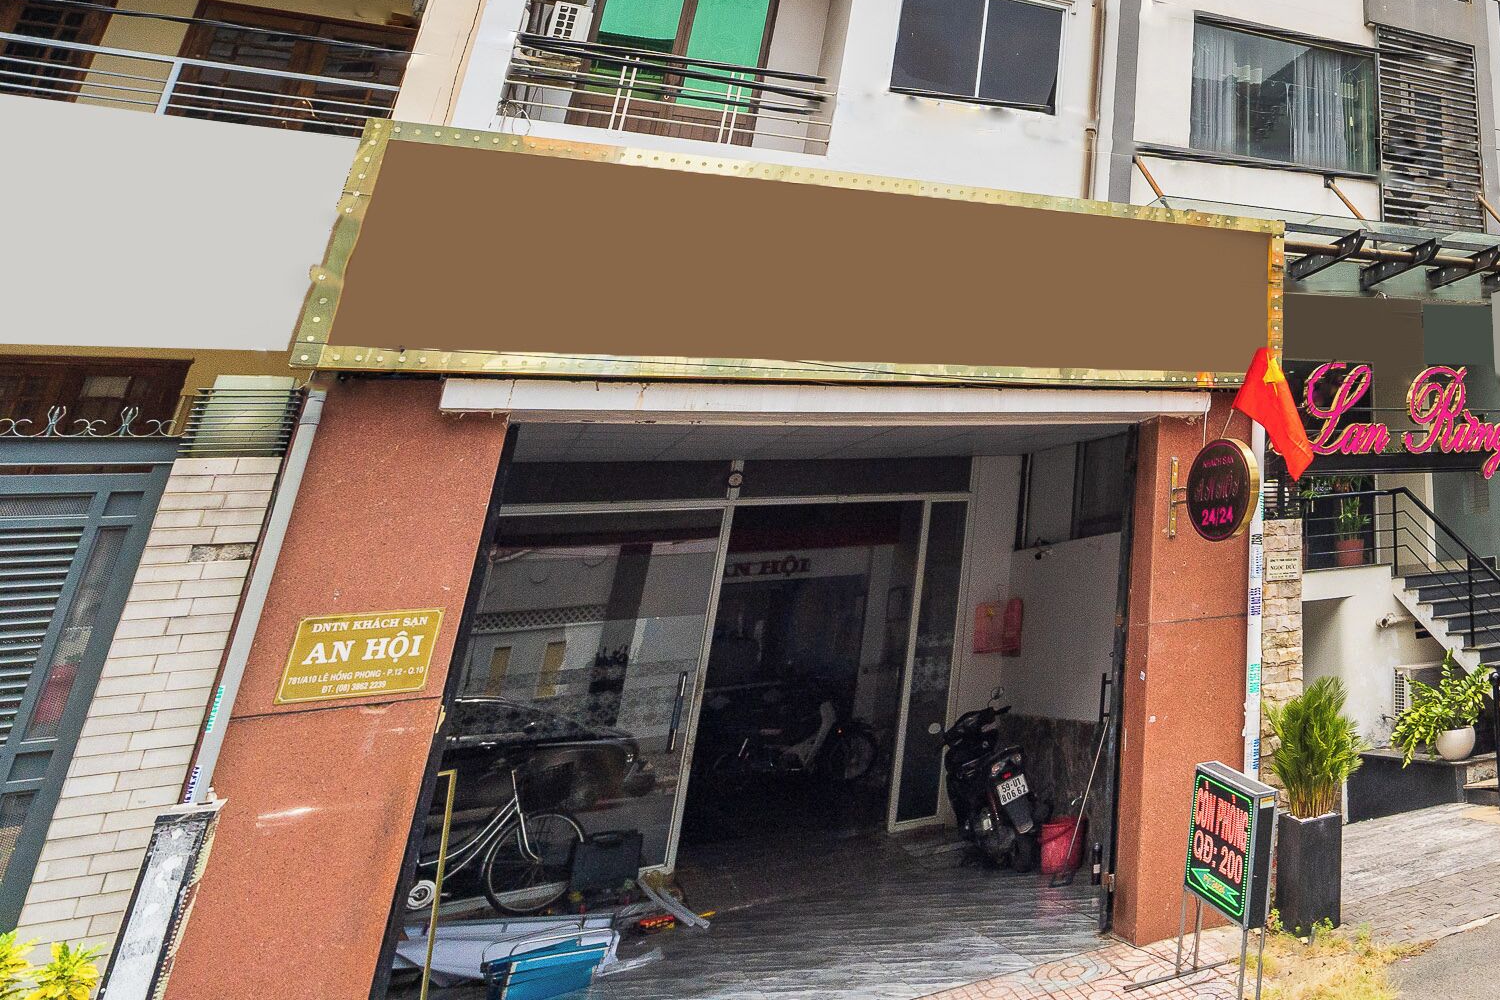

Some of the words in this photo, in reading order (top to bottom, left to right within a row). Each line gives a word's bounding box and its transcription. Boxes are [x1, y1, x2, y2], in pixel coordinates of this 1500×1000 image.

[1304, 361, 1389, 455] Lan
[1201, 505, 1233, 526] 24/24
[760, 555, 810, 576] HỘI
[312, 622, 348, 633] DNTN
[352, 617, 400, 630] KHÁCH
[402, 616, 428, 628] SẠN
[302, 640, 355, 665] AN
[362, 631, 424, 663] HỘI
[318, 672, 330, 683] LÊ
[330, 669, 353, 682] HỒNG
[354, 668, 382, 679] PHONG
[387, 667, 402, 677] P.12
[407, 666, 424, 676] Q.10
[1001, 778, 1022, 793] 59-U1
[1002, 784, 1027, 803] 806.62
[1195, 780, 1217, 832] CÒN
[1215, 795, 1249, 854] PHÒNG
[1193, 829, 1218, 868] QĐ:
[1218, 845, 1244, 884] 200
